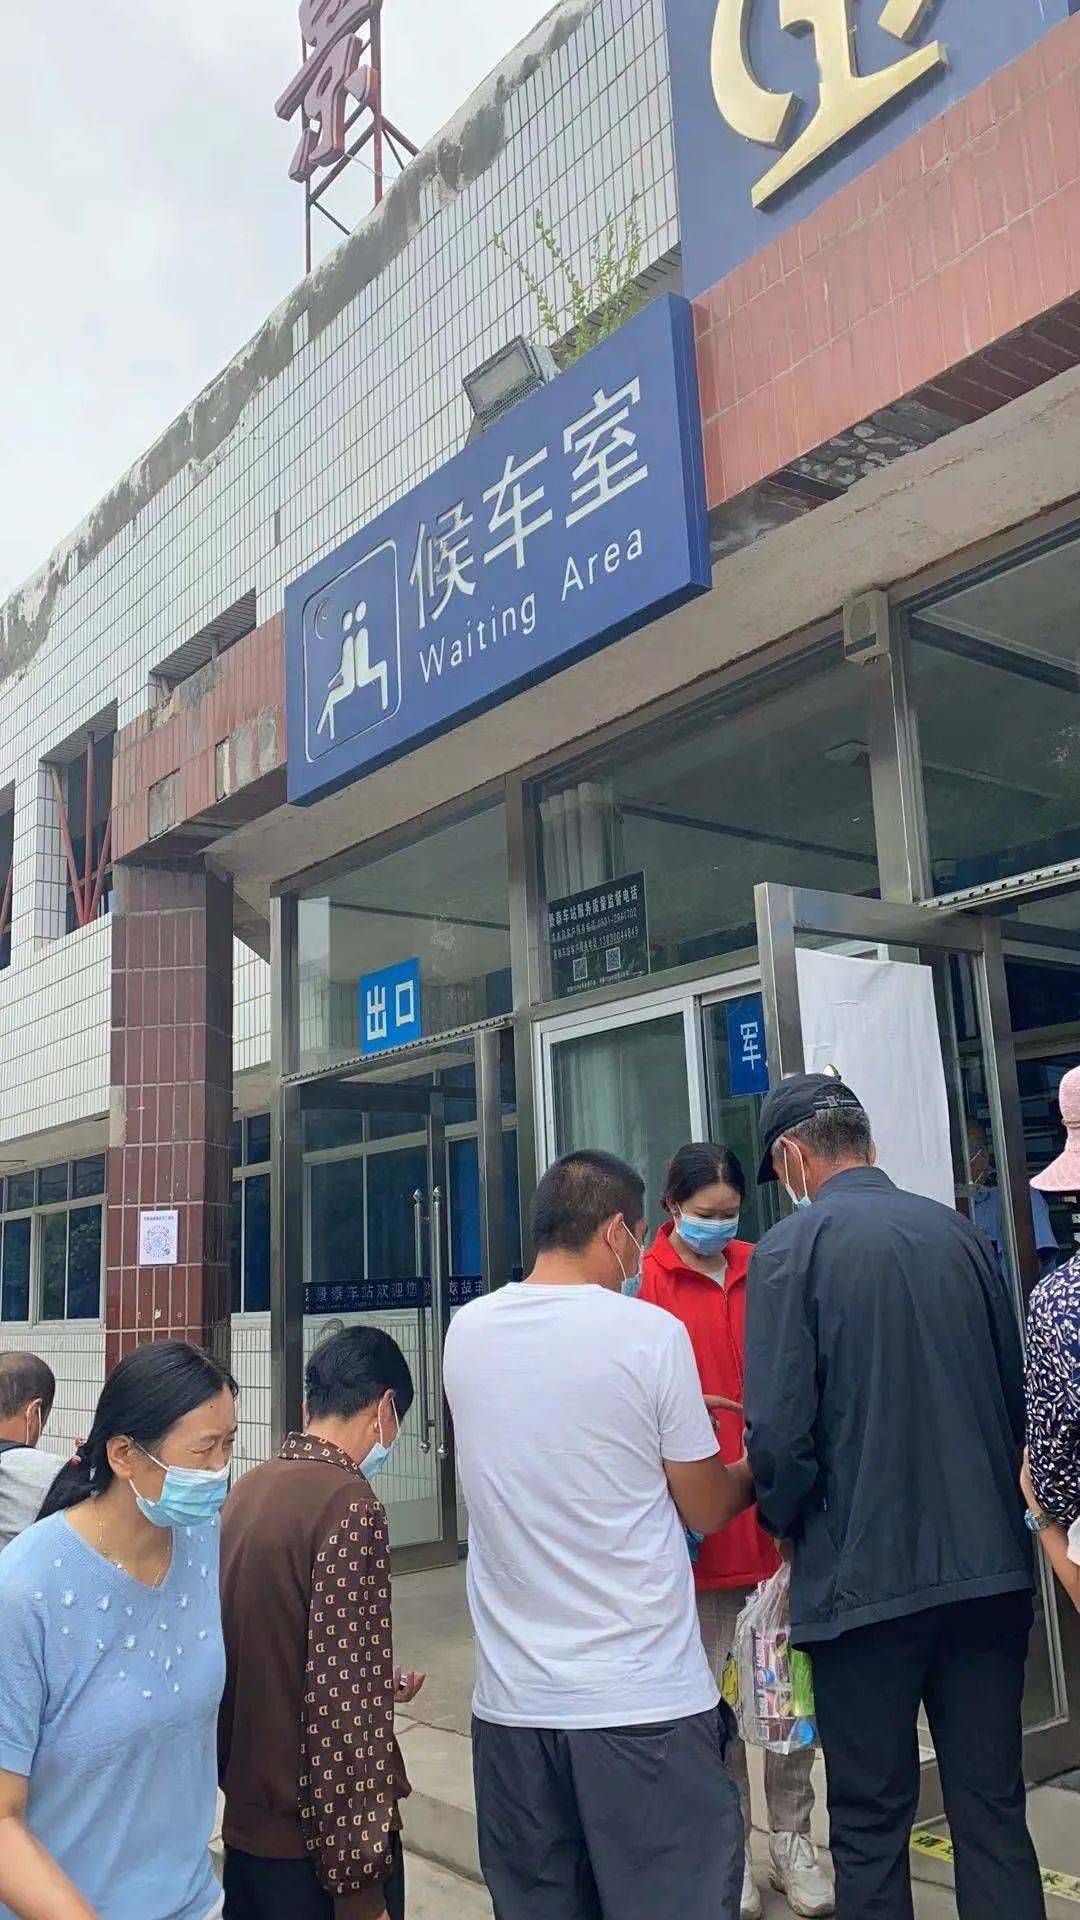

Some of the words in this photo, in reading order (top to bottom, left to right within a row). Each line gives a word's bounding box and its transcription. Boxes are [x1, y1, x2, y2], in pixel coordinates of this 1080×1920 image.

[408, 376, 648, 630] 候车室
[419, 592, 537, 684] Waiting
[561, 528, 643, 602] Area
[367, 980, 414, 1041] 出口
[740, 1021, 768, 1071] 军
